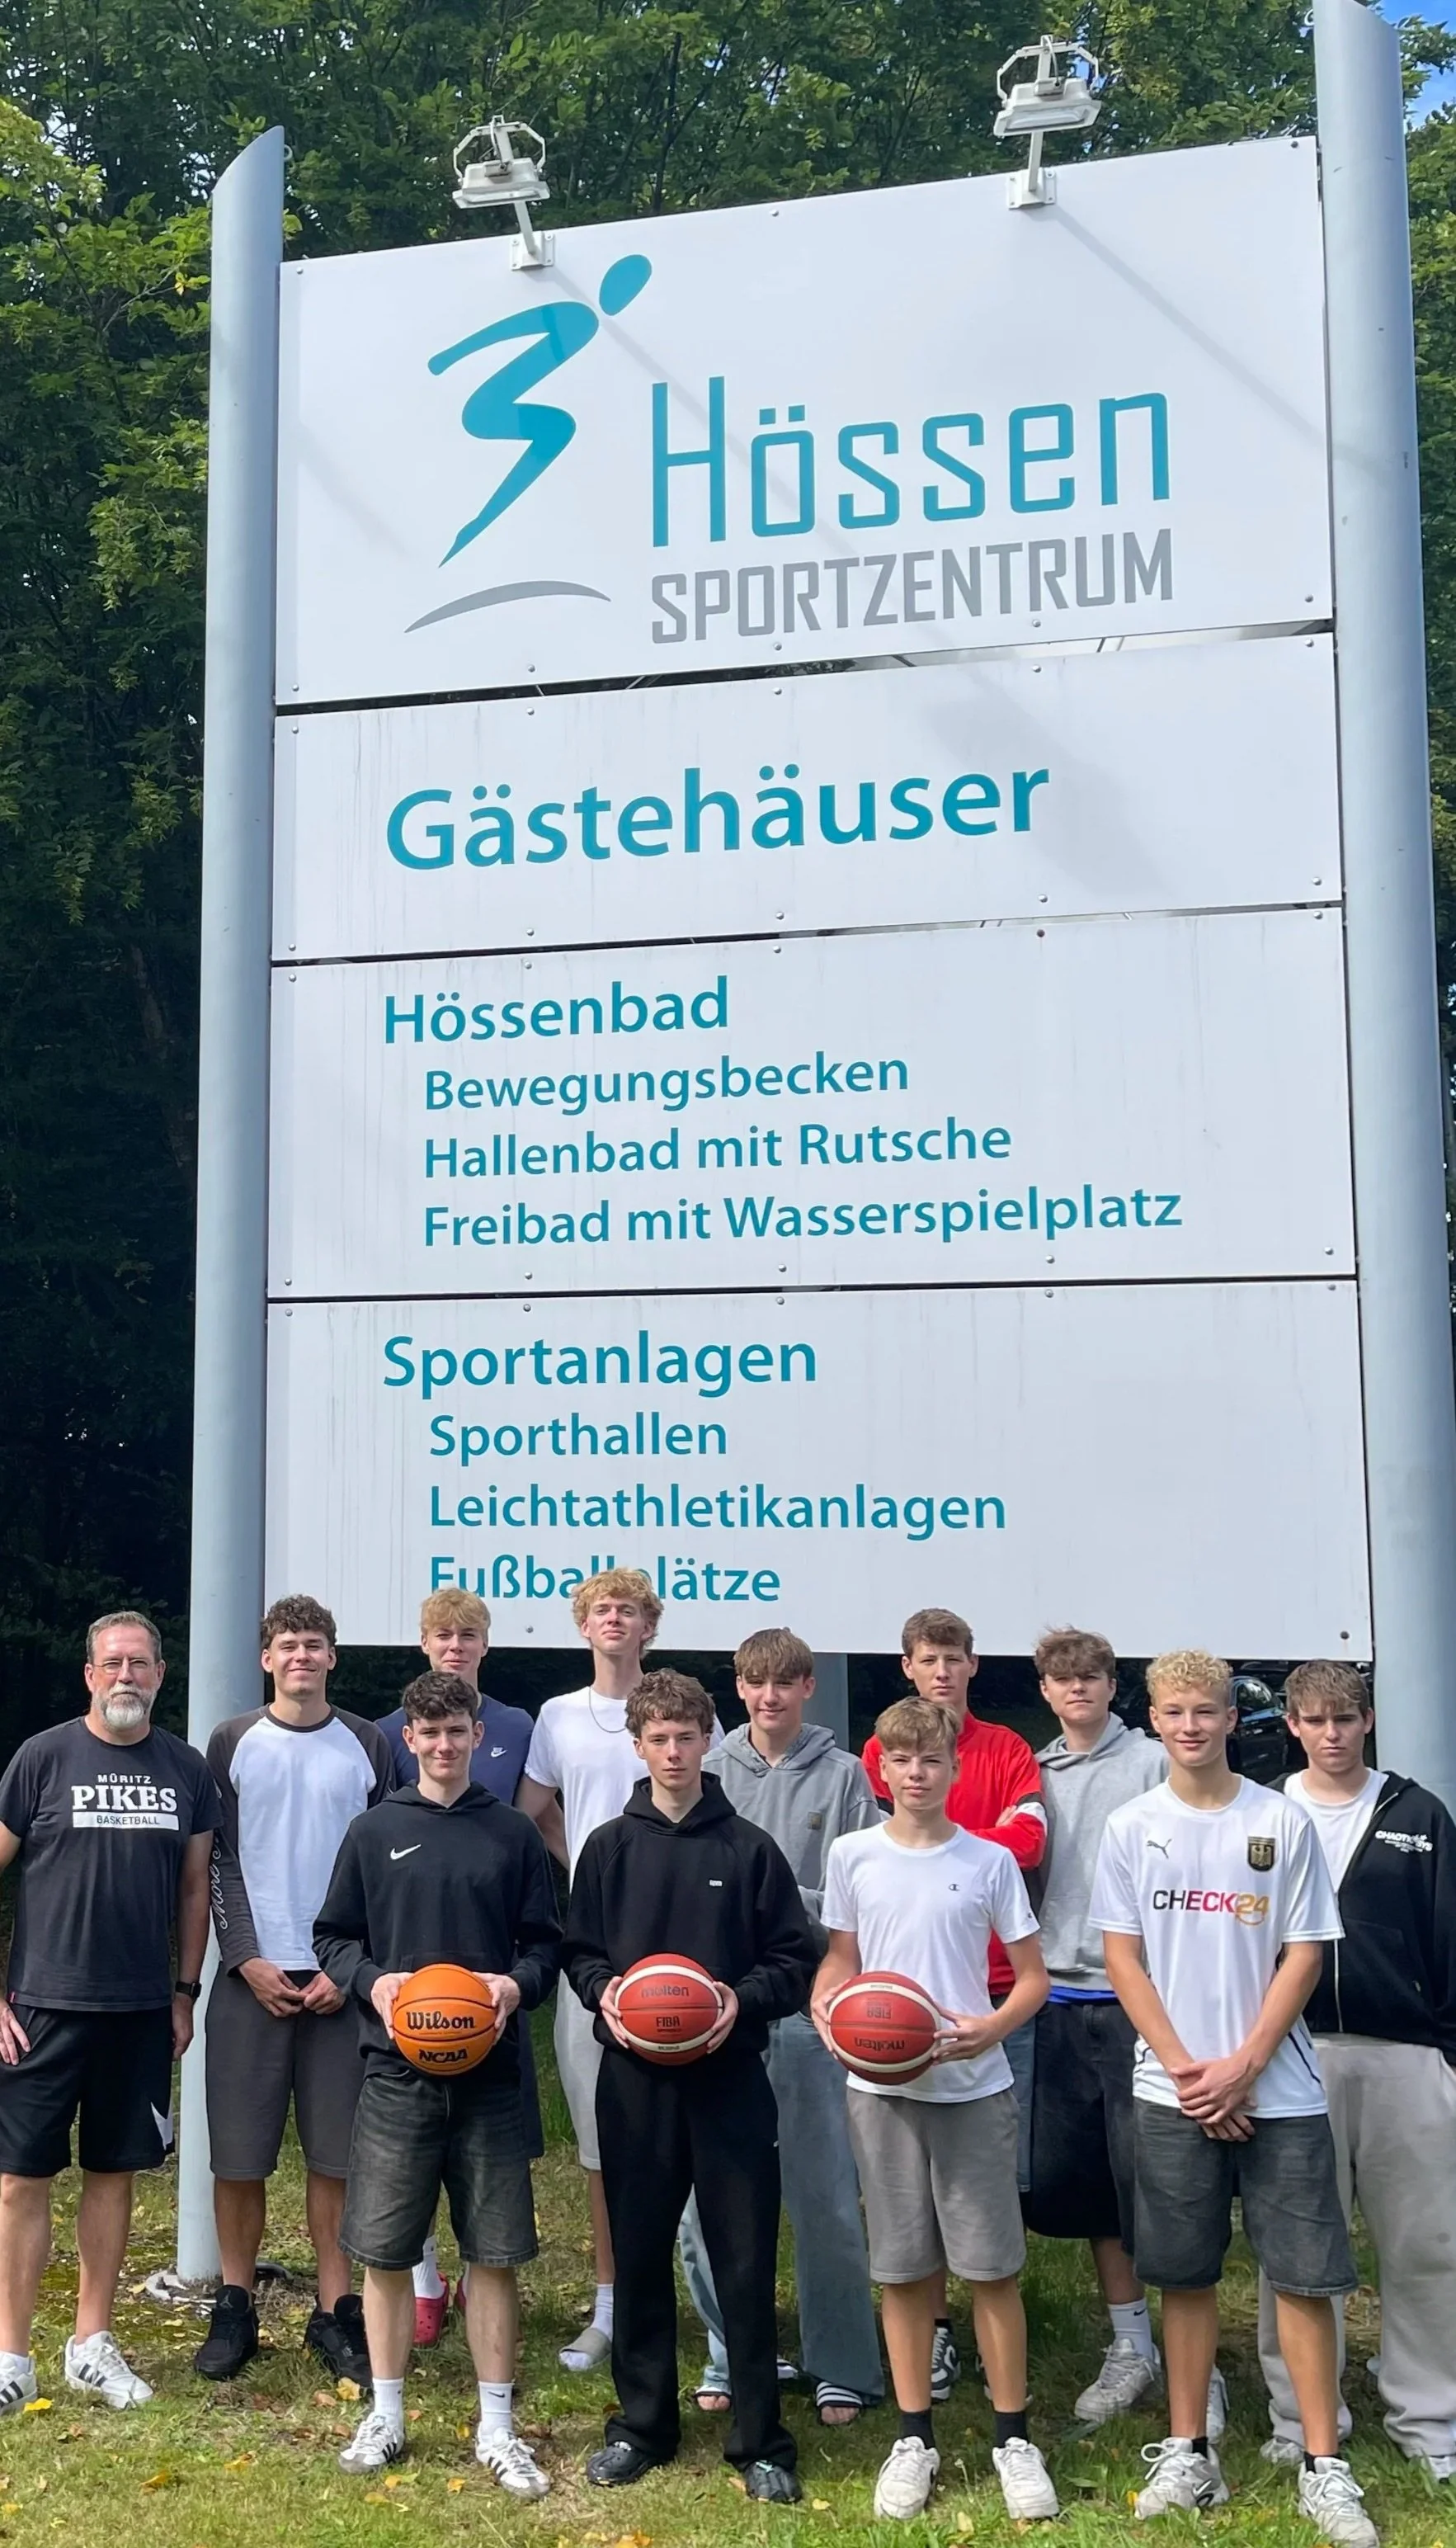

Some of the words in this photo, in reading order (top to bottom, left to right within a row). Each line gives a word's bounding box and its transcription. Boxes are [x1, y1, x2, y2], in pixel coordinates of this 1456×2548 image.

[652, 375, 1171, 549] Hössen
[652, 528, 1172, 644] SPORTZENTRUM
[386, 762, 1050, 871] Gästehäuser
[384, 974, 729, 1045] Hössenbad
[425, 1051, 909, 1116] Bewegungsbecken
[425, 1126, 681, 1178] Hallenbad
[697, 1125, 782, 1169] mit
[799, 1116, 1011, 1166] Rutsche
[424, 1200, 610, 1248] Freibad
[626, 1198, 711, 1242] mit
[723, 1182, 1182, 1243] Wasserspielplatz
[383, 1328, 818, 1401] Sportanlagen
[429, 1411, 727, 1467] Sporthallen
[430, 1482, 1006, 1542] Leichtathletikanlagen
[430, 1553, 782, 1603] Fußbalätze
[71, 1785, 177, 1812] PIKES
[97, 1773, 152, 1784] MÜRITZ
[97, 1815, 160, 1825] BASKETBALL
[1152, 1889, 1270, 1916] CHECK24
[641, 1985, 690, 1998] molten
[406, 2011, 476, 2030] Wilson
[656, 2015, 681, 2027] FIBA
[854, 2036, 906, 2051] molten
[418, 2048, 469, 2063] NCAA
